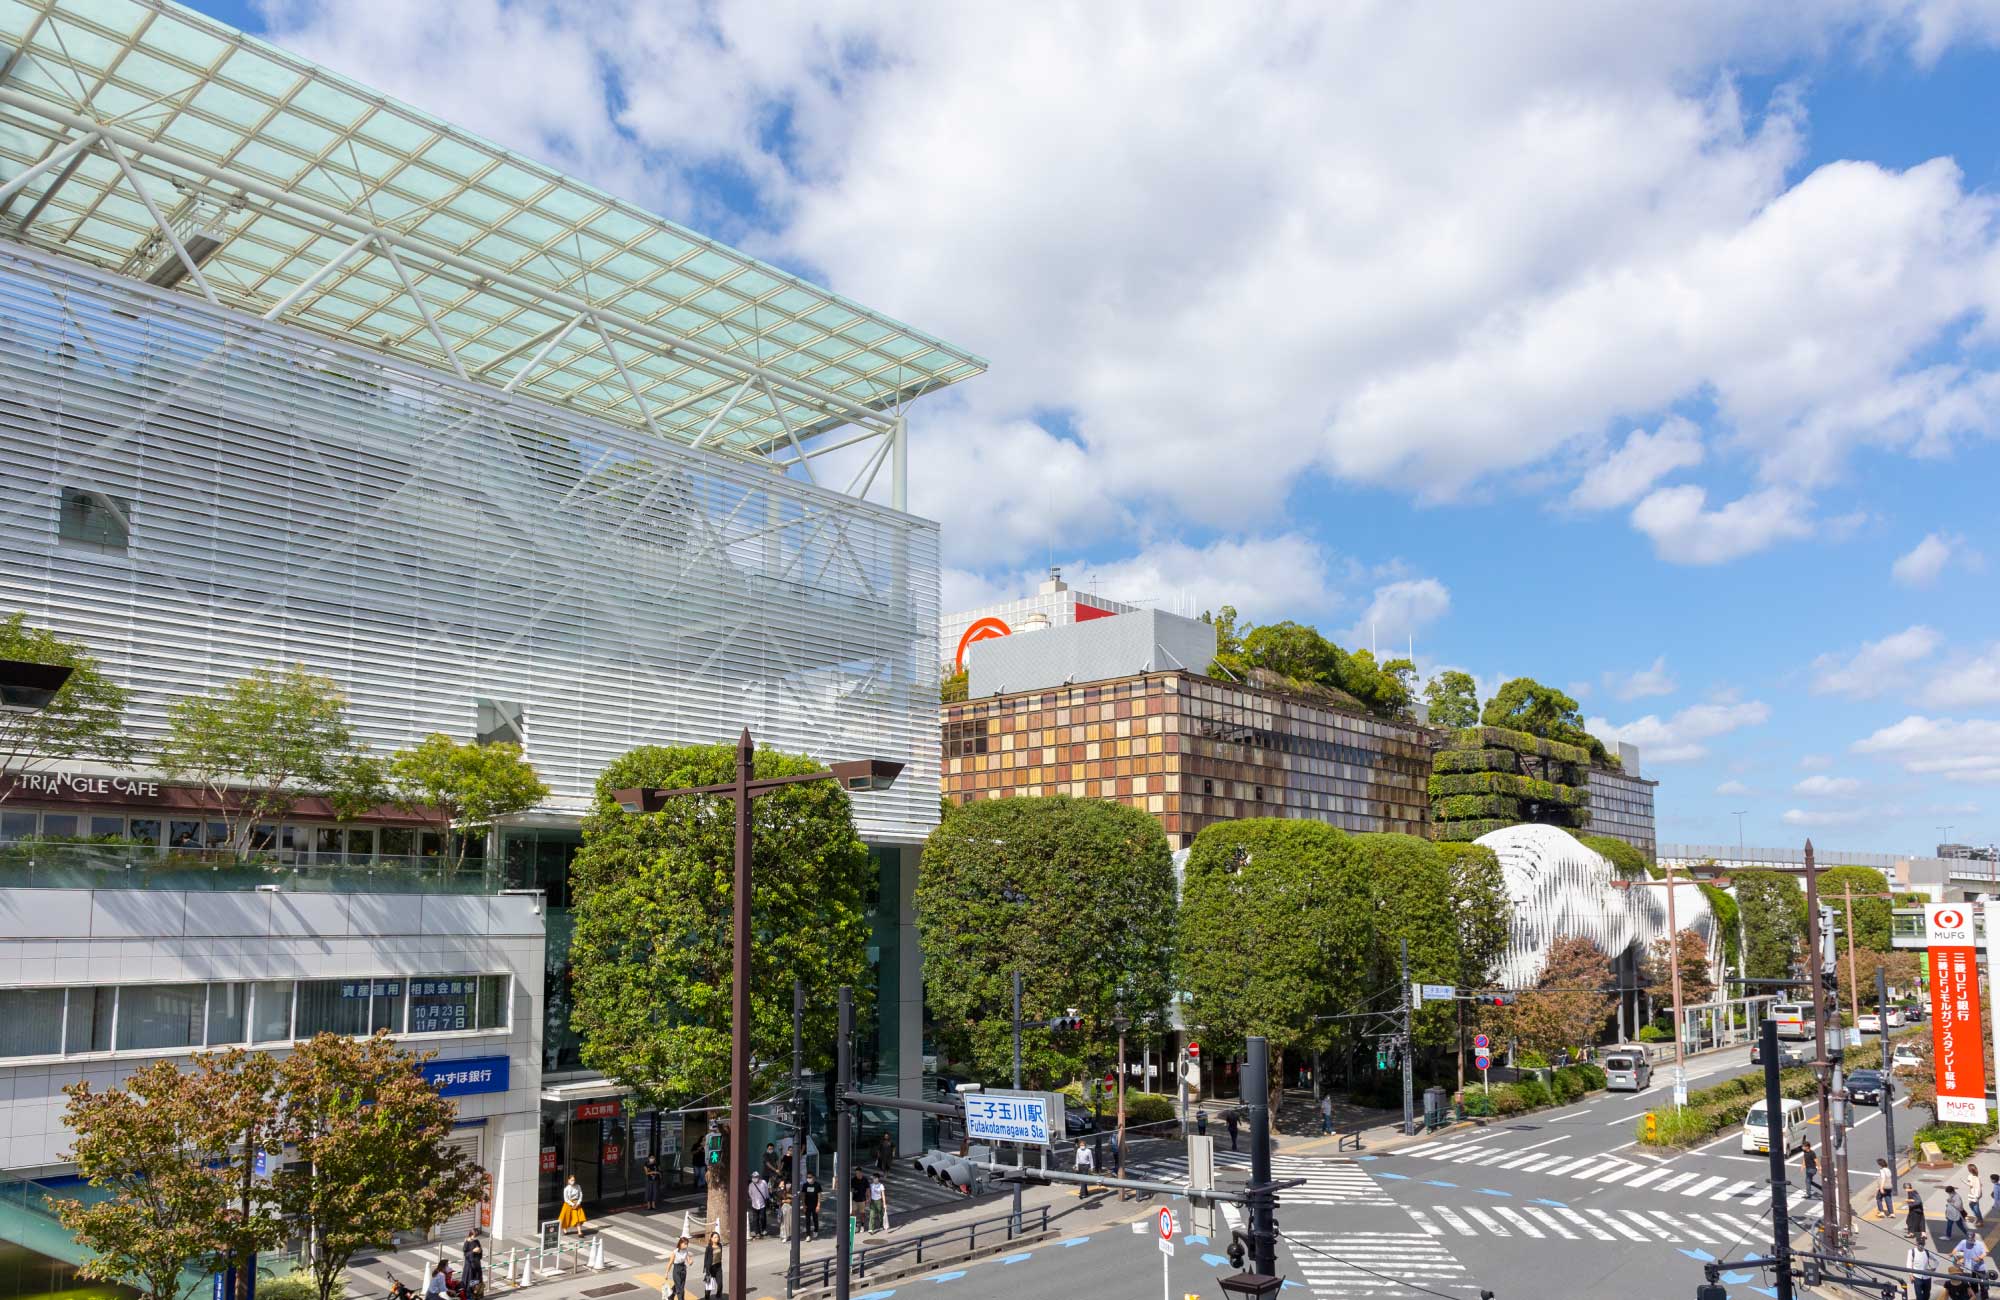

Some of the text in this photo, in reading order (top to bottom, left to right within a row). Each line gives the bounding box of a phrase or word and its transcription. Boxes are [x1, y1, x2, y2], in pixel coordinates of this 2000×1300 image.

[20, 771, 159, 797] TRIANGLE CAFE
[1934, 931, 1965, 940] MUFG
[433, 1069, 492, 1086] みずほ銀行
[969, 1101, 1044, 1122] 二子玉川駅
[1946, 1101, 1976, 1110] MUFG
[970, 1119, 1045, 1138] Futakotamagawa Sta.
